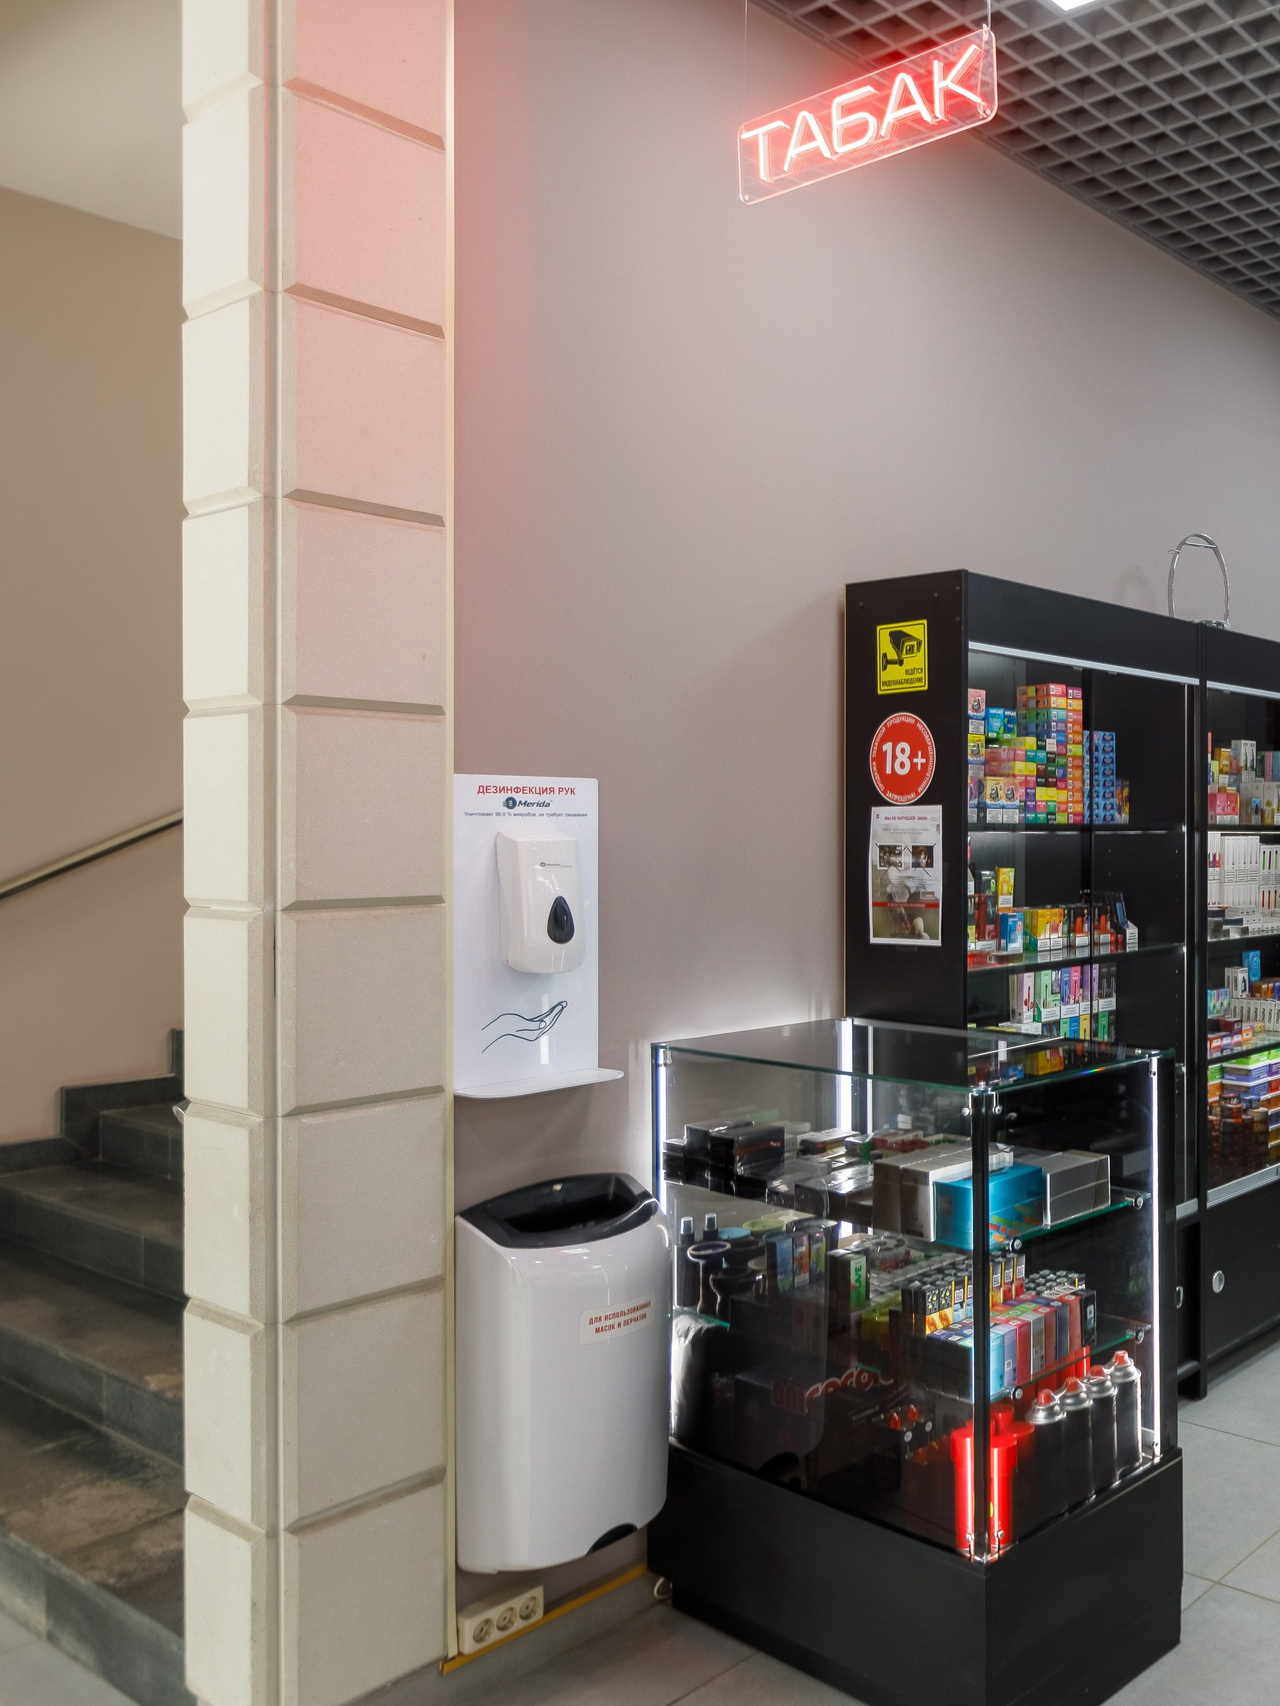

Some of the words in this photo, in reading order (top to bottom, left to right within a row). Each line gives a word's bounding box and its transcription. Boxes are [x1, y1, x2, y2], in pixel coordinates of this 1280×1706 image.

[741, 43, 985, 183] ТАБАК
[882, 741, 926, 776] 18+
[477, 785, 555, 796] ДЕЗИНФЕКЦИЯ
[558, 787, 576, 796] РУК
[517, 800, 551, 808] Merida
[588, 1315, 602, 1326] ДЛЯ
[604, 1300, 651, 1322] ИСПОЛЬЗОВАННЫХ
[594, 1323, 615, 1334] МАСОК
[617, 1321, 622, 1329] И
[623, 1312, 647, 1327] ПЕРЧАТОК
